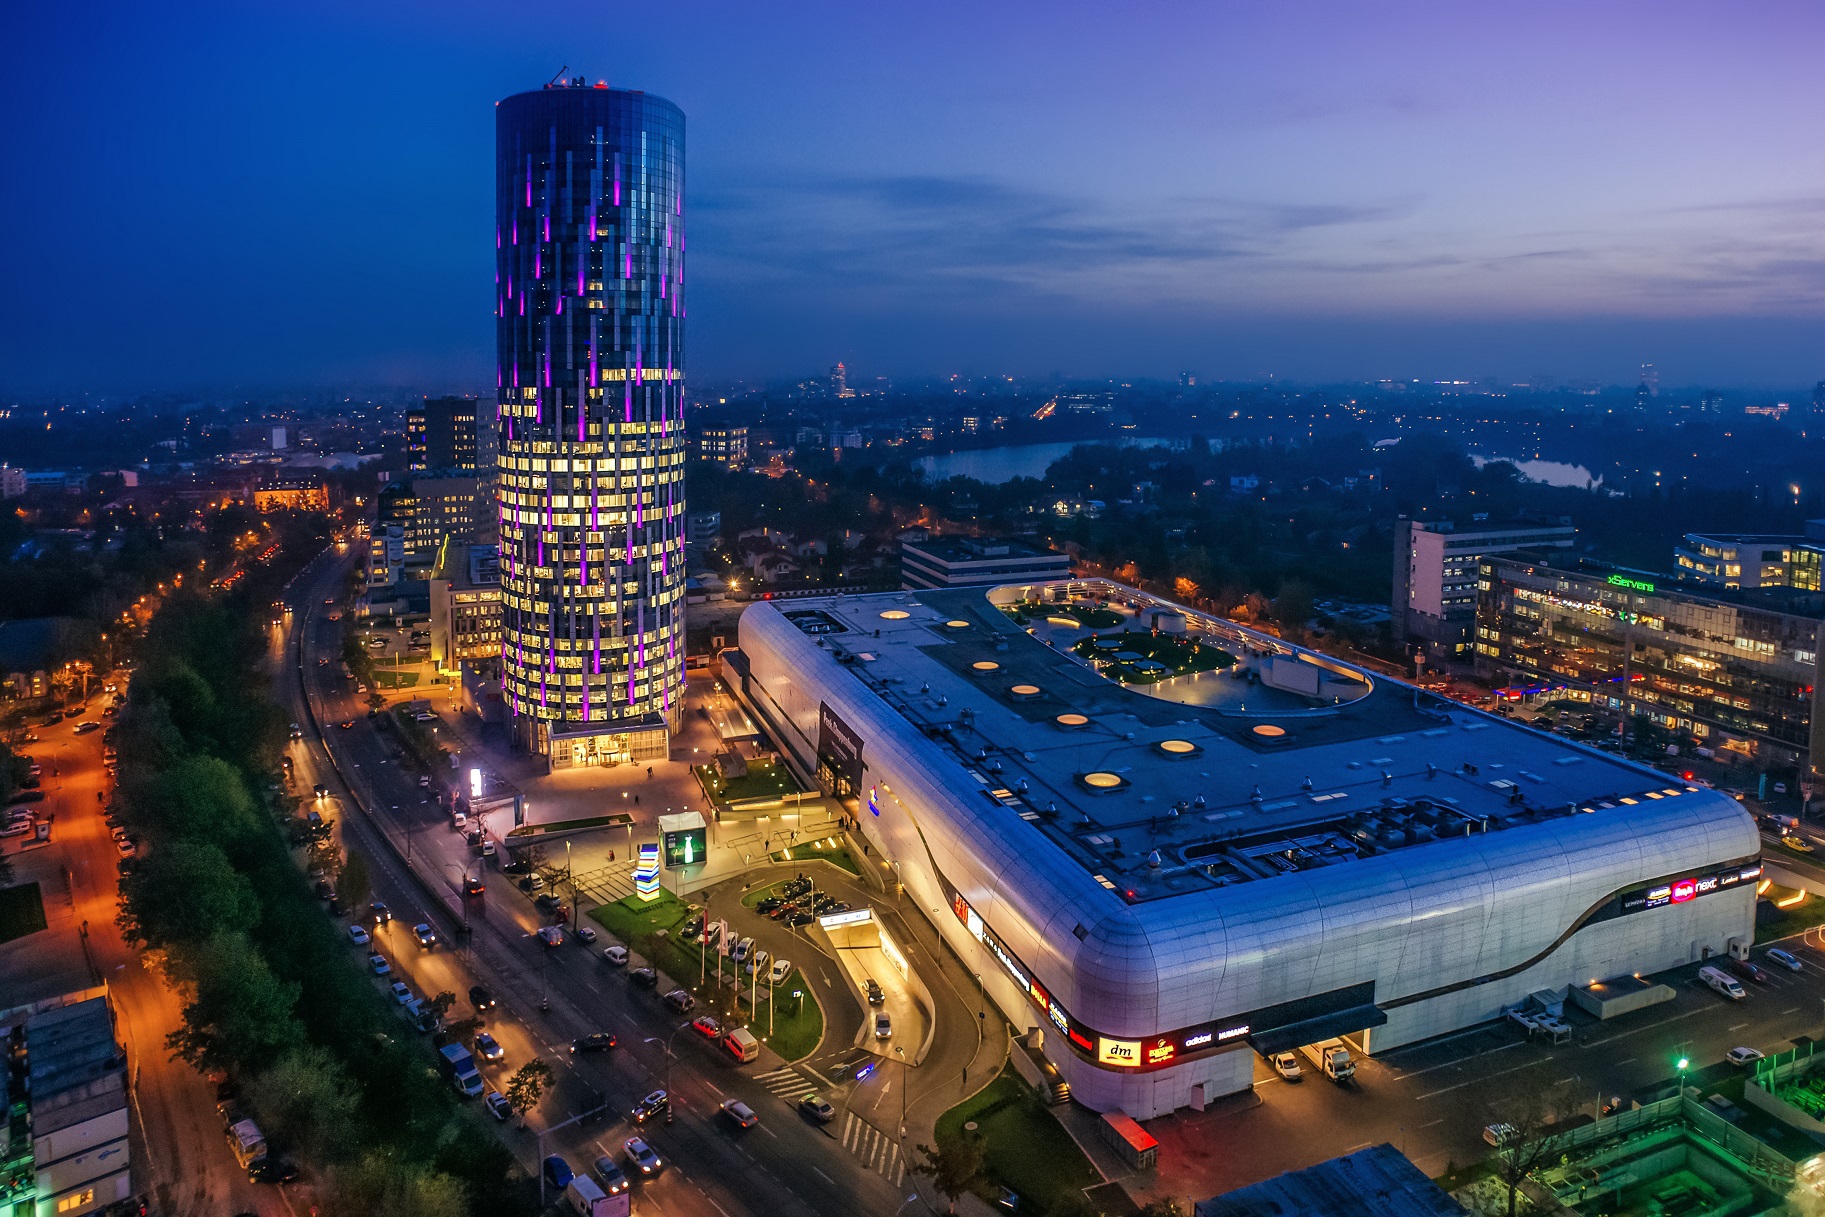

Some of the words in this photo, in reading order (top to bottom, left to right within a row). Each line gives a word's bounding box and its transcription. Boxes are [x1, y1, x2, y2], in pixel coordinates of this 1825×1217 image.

[1608, 575, 1654, 592] xServers
[1695, 877, 1718, 892] next
[1185, 1033, 1212, 1047] adidas
[1218, 1025, 1250, 1041] HUMANIC
[1110, 1045, 1131, 1057] dm
